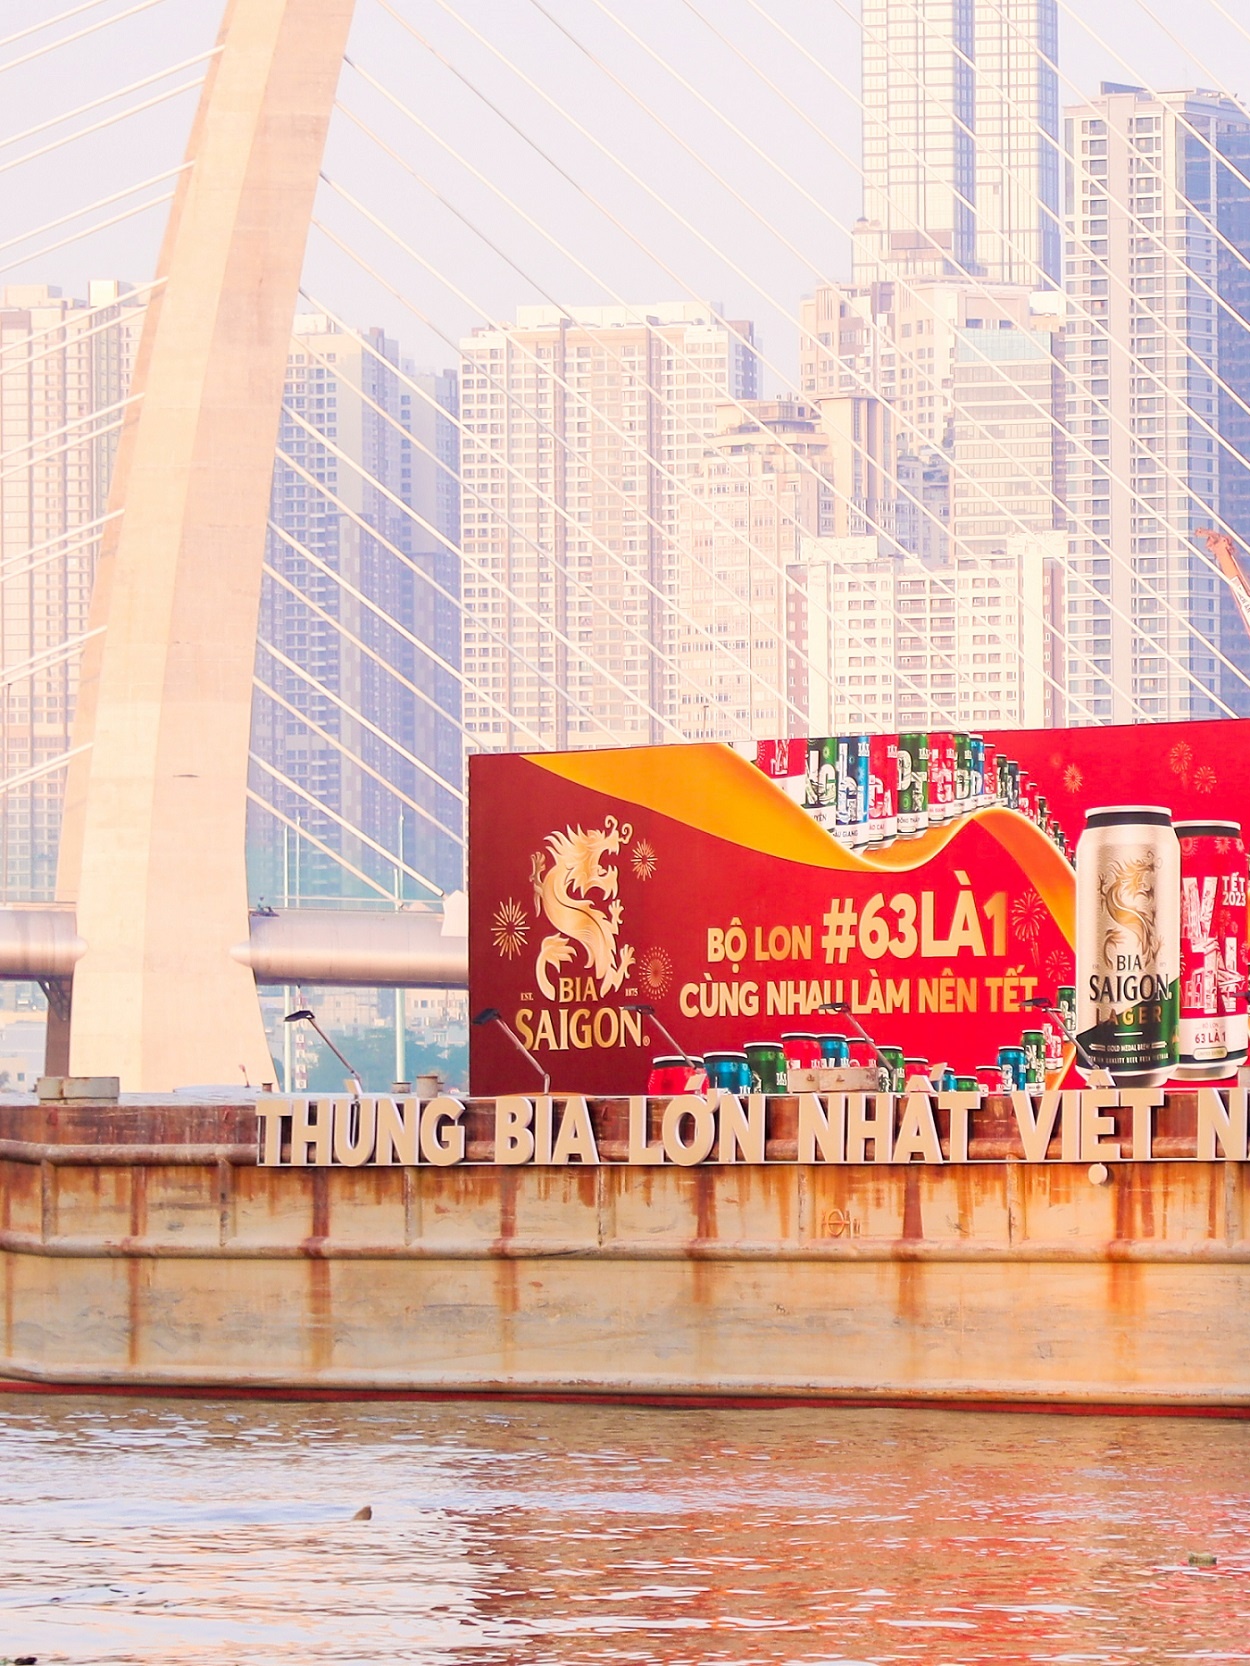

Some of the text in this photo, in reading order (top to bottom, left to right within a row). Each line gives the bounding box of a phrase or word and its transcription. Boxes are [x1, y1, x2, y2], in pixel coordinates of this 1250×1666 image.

[1222, 872, 1246, 893] TẾT
[1222, 891, 1247, 907] 2023
[821, 869, 1008, 965] #63LÀ1
[707, 916, 812, 974] BỘ LON
[1116, 953, 1143, 972] BIA
[558, 976, 599, 1003] BIA
[679, 964, 1039, 1019] CÙNG NHAU LÀM NÊN TẾT
[1089, 973, 1170, 1003] SAIGON
[515, 1006, 643, 1051] SAIGON
[1094, 1005, 1163, 1027] LAGER
[1194, 1028, 1226, 1044] 63 LÀ 1
[255, 1078, 466, 1167] THÙNG
[494, 1094, 602, 1166] BIA
[627, 1072, 769, 1167] LỚN
[797, 1061, 981, 1165] NHẤT
[1009, 1069, 1165, 1185] VIỆT
